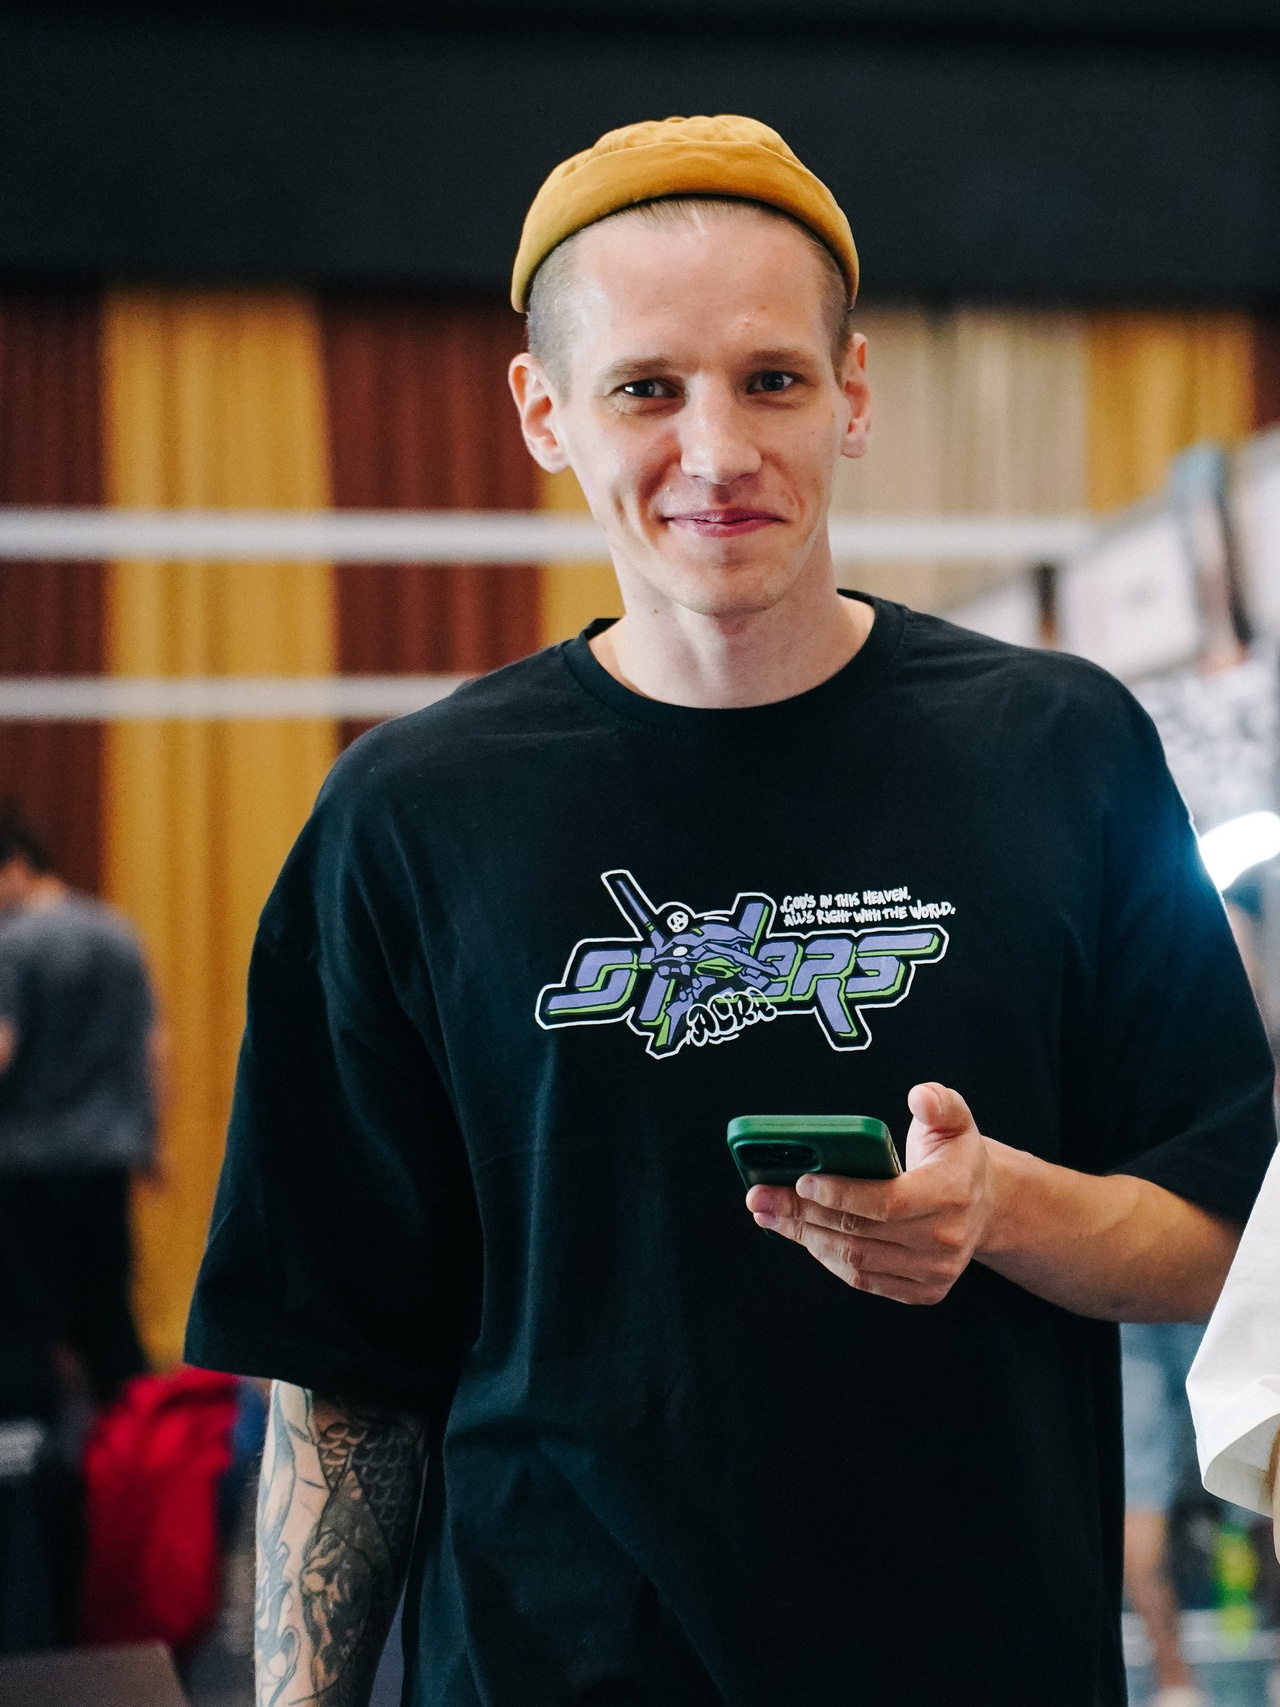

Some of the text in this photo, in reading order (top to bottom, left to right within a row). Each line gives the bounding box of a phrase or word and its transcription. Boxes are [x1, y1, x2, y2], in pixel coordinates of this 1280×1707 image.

[820, 893, 833, 909] IN
[834, 892, 860, 908] THIS
[863, 886, 911, 905] HEAVEN.
[816, 909, 852, 925] RIGHT
[853, 908, 882, 923] WITH
[882, 905, 908, 920] THE
